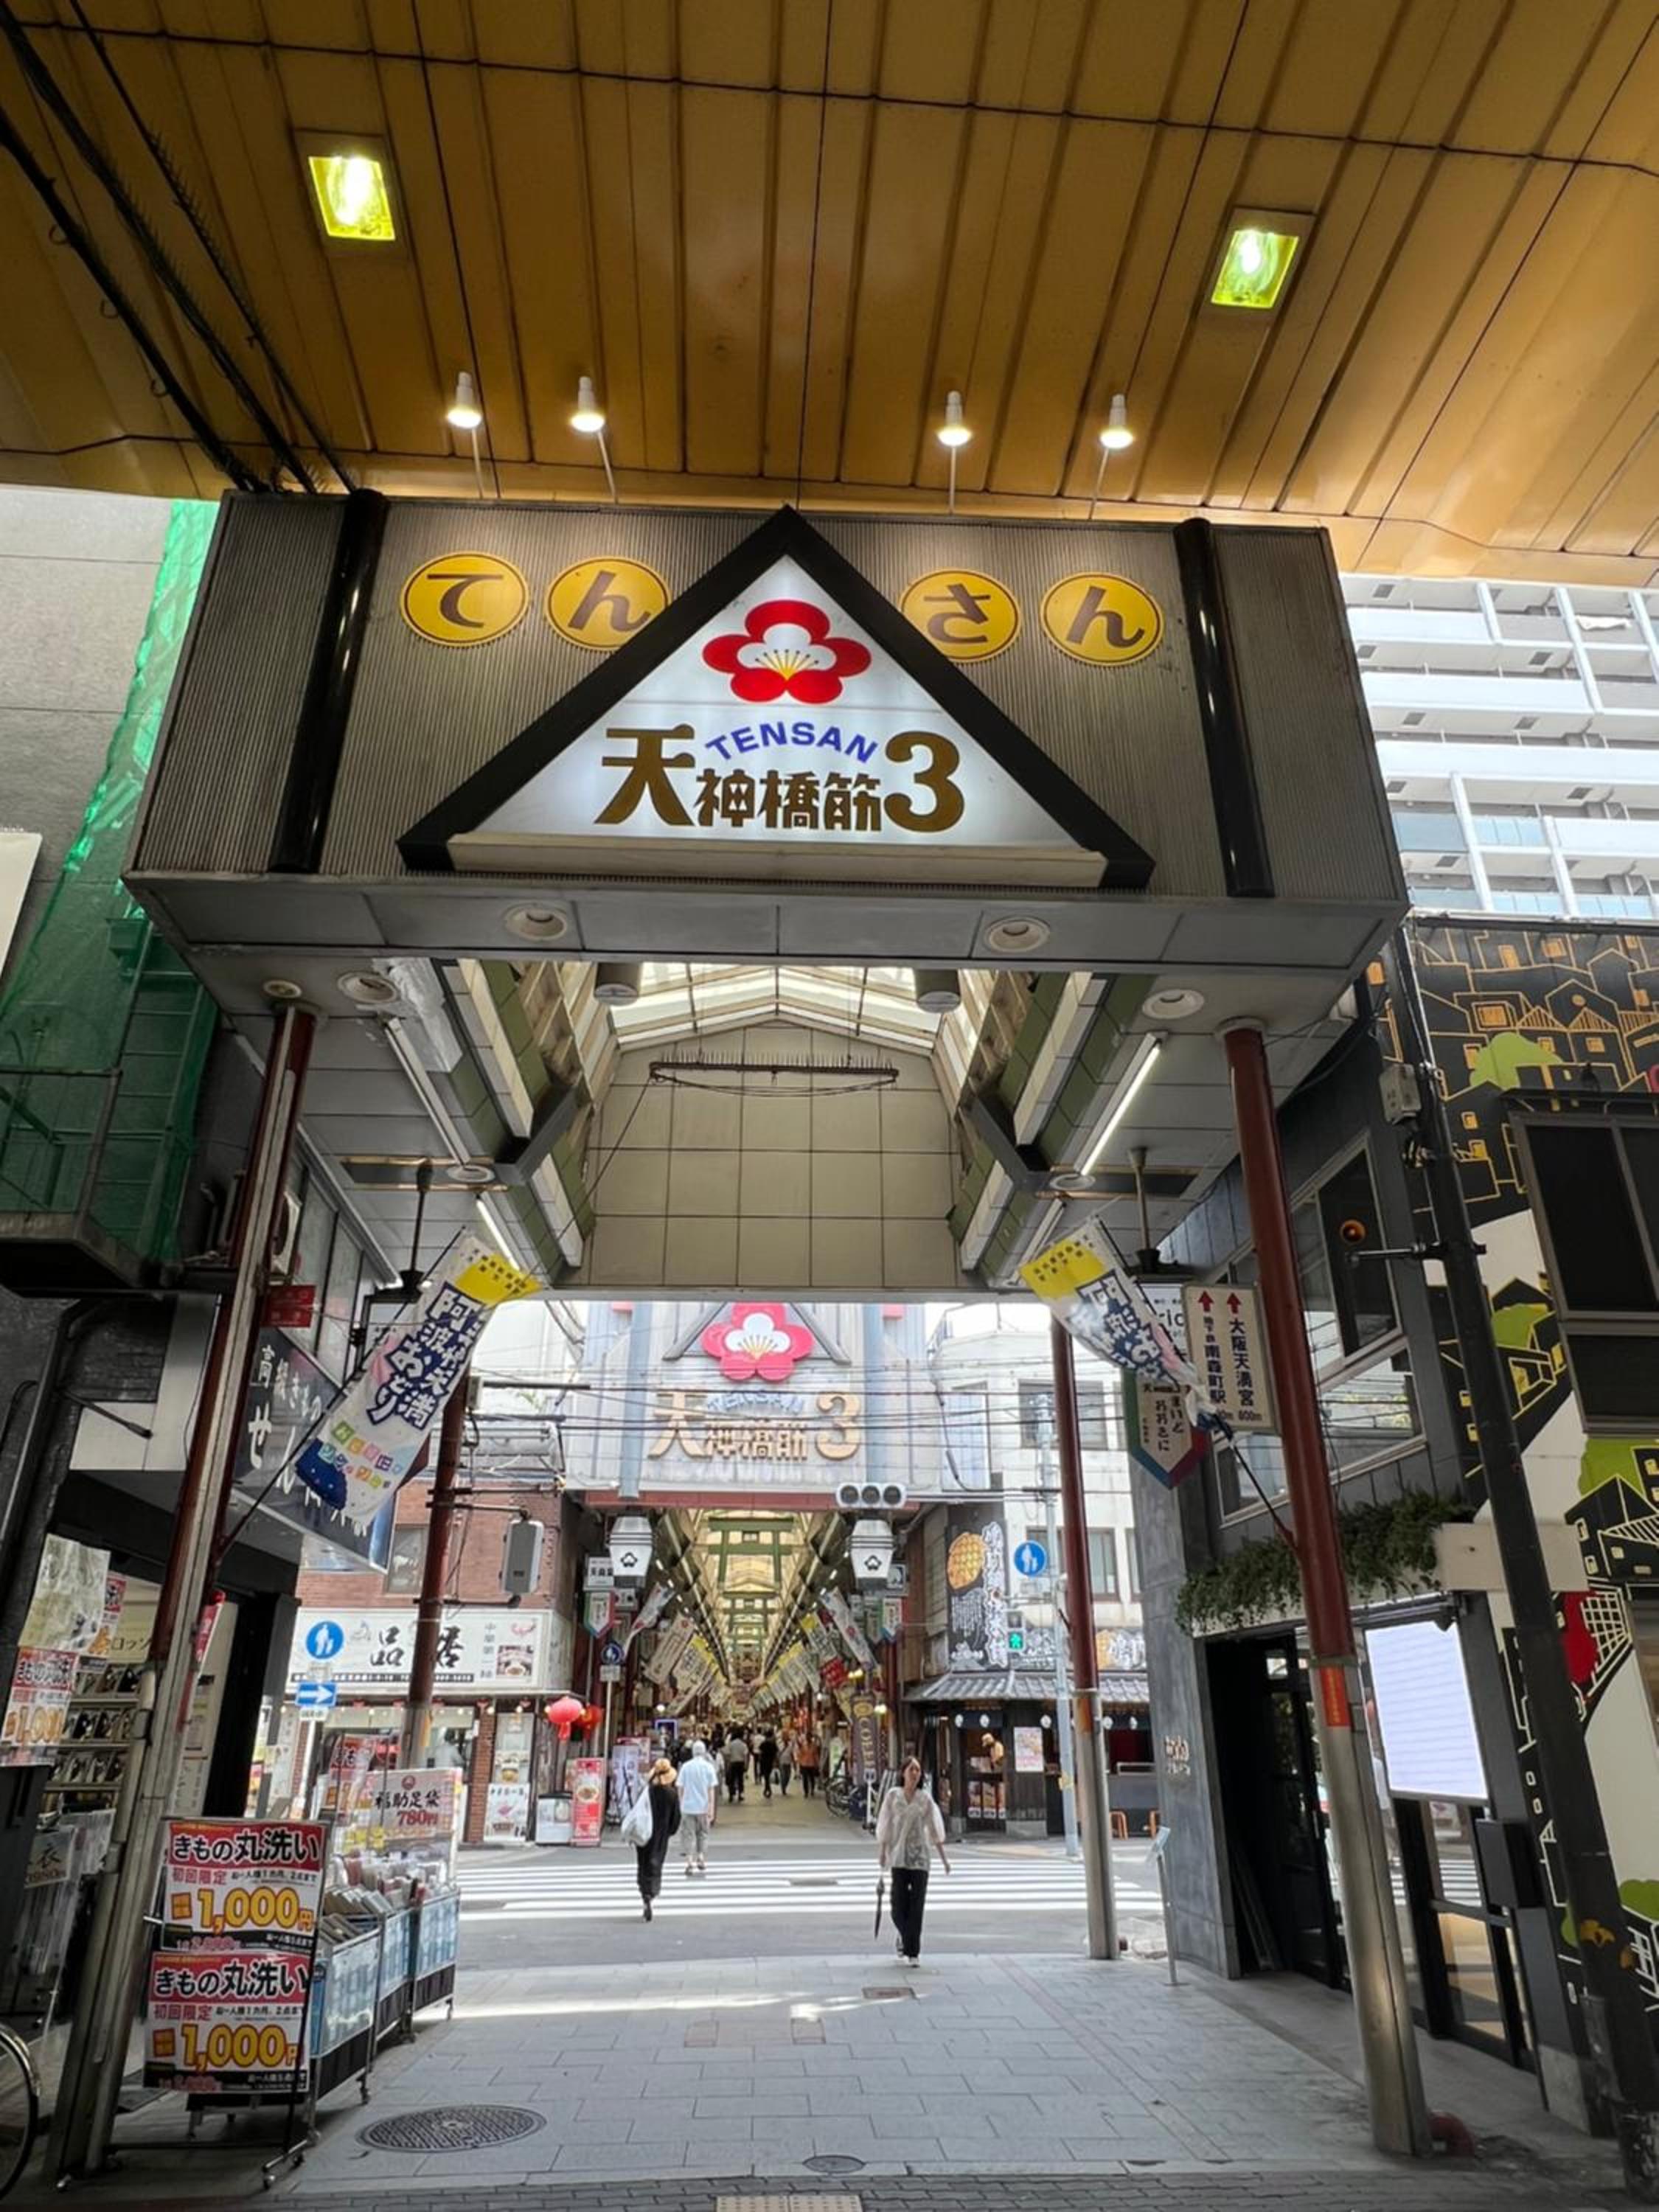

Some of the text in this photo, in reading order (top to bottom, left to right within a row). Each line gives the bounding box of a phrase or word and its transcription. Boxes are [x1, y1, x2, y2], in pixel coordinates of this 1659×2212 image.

[704, 721, 878, 763] TENSAN
[594, 724, 966, 833] 天神橋筋3
[173, 1828, 320, 1863] きもの丸洗い
[156, 1959, 310, 1997] きもの丸洗い
